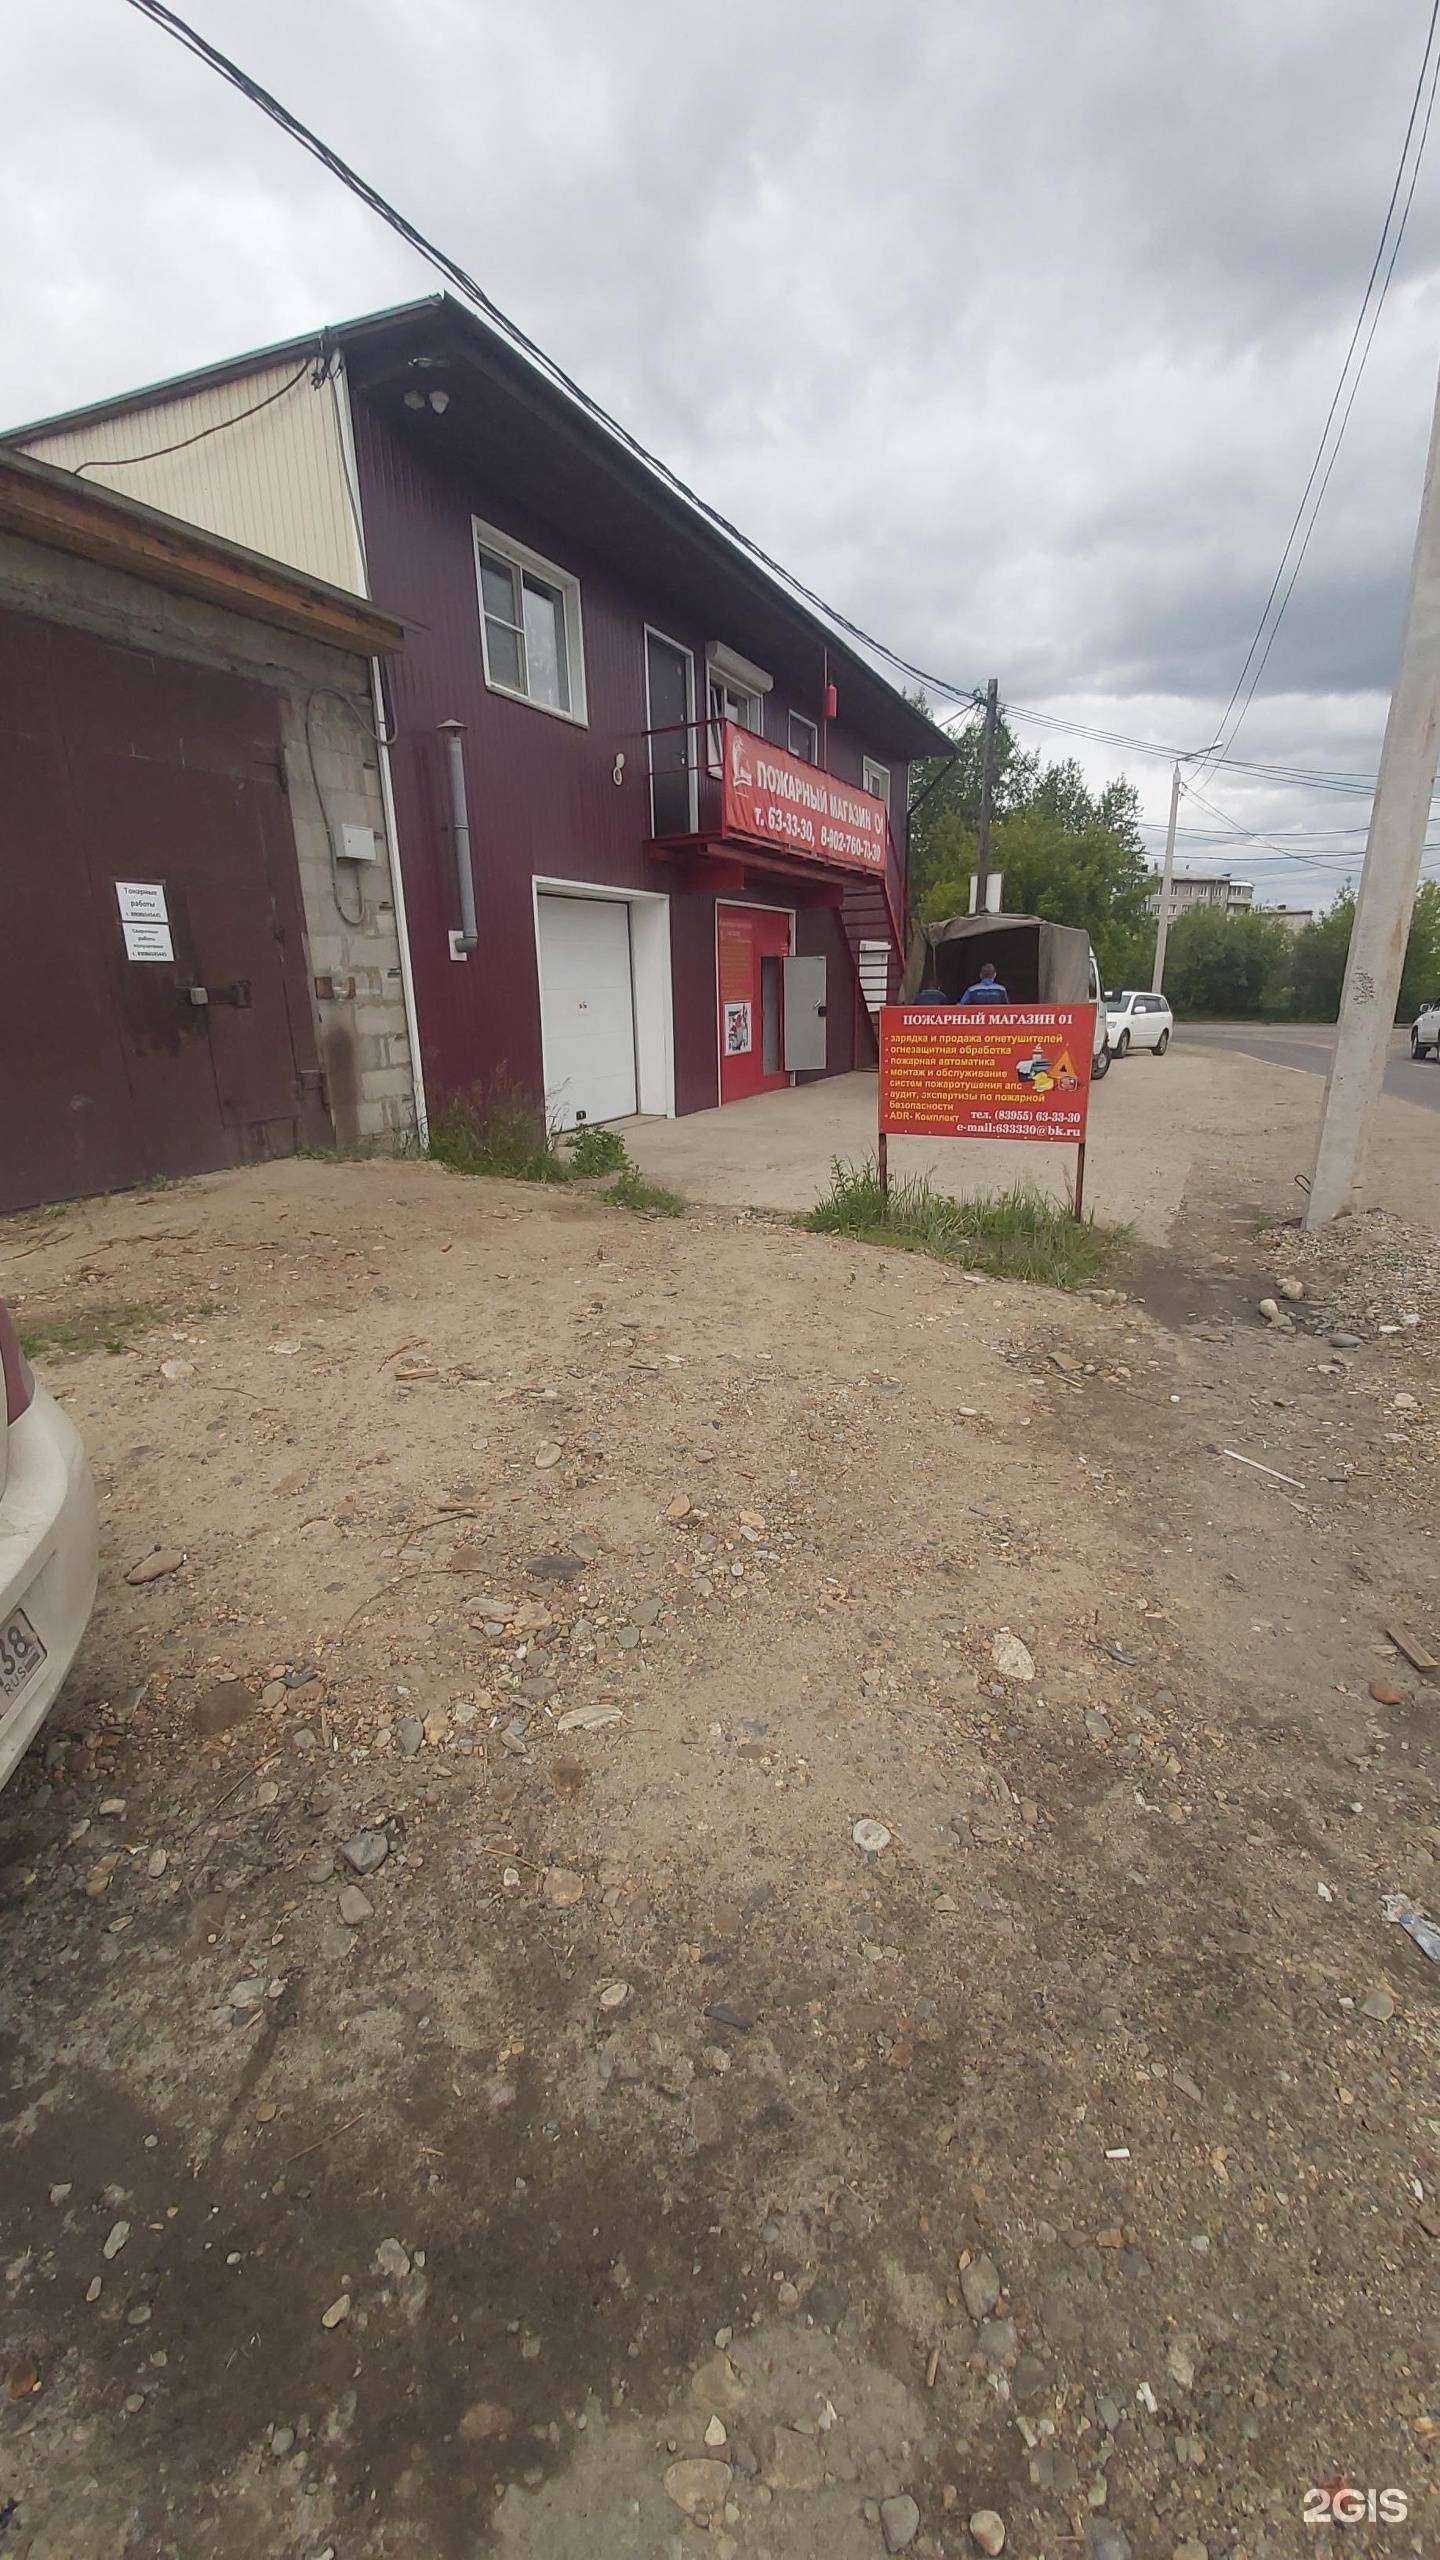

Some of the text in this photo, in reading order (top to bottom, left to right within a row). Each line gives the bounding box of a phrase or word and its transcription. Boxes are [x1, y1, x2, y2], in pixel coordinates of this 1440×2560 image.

[757, 760, 828, 814] ПОЖАРНЫЙ
[829, 794, 871, 831] МАГАЗИН
[768, 806, 815, 847] 63-33-30,
[903, 1012, 1073, 1026] ПОЖАРНЫЙ МАГАЗИН 01
[890, 1035, 928, 1045] зарядка
[939, 1035, 982, 1045] продажа
[984, 1034, 1063, 1044] огнетушителей
[890, 1045, 1012, 1056] огнезащитная обработка
[890, 1058, 996, 1067] пожарная автоматика
[890, 1069, 926, 1077] монтаж
[935, 1068, 1008, 1079] обслуживание
[889, 1080, 923, 1088] систем
[925, 1081, 1003, 1091] пожаротушения
[921, 1092, 978, 1102] экспертизы
[980, 1093, 992, 1101] по
[994, 1093, 1045, 1104] пожарной
[889, 1101, 954, 1111] безопасности
[970, 1110, 1081, 1123] тел. (83955) 63-33-30
